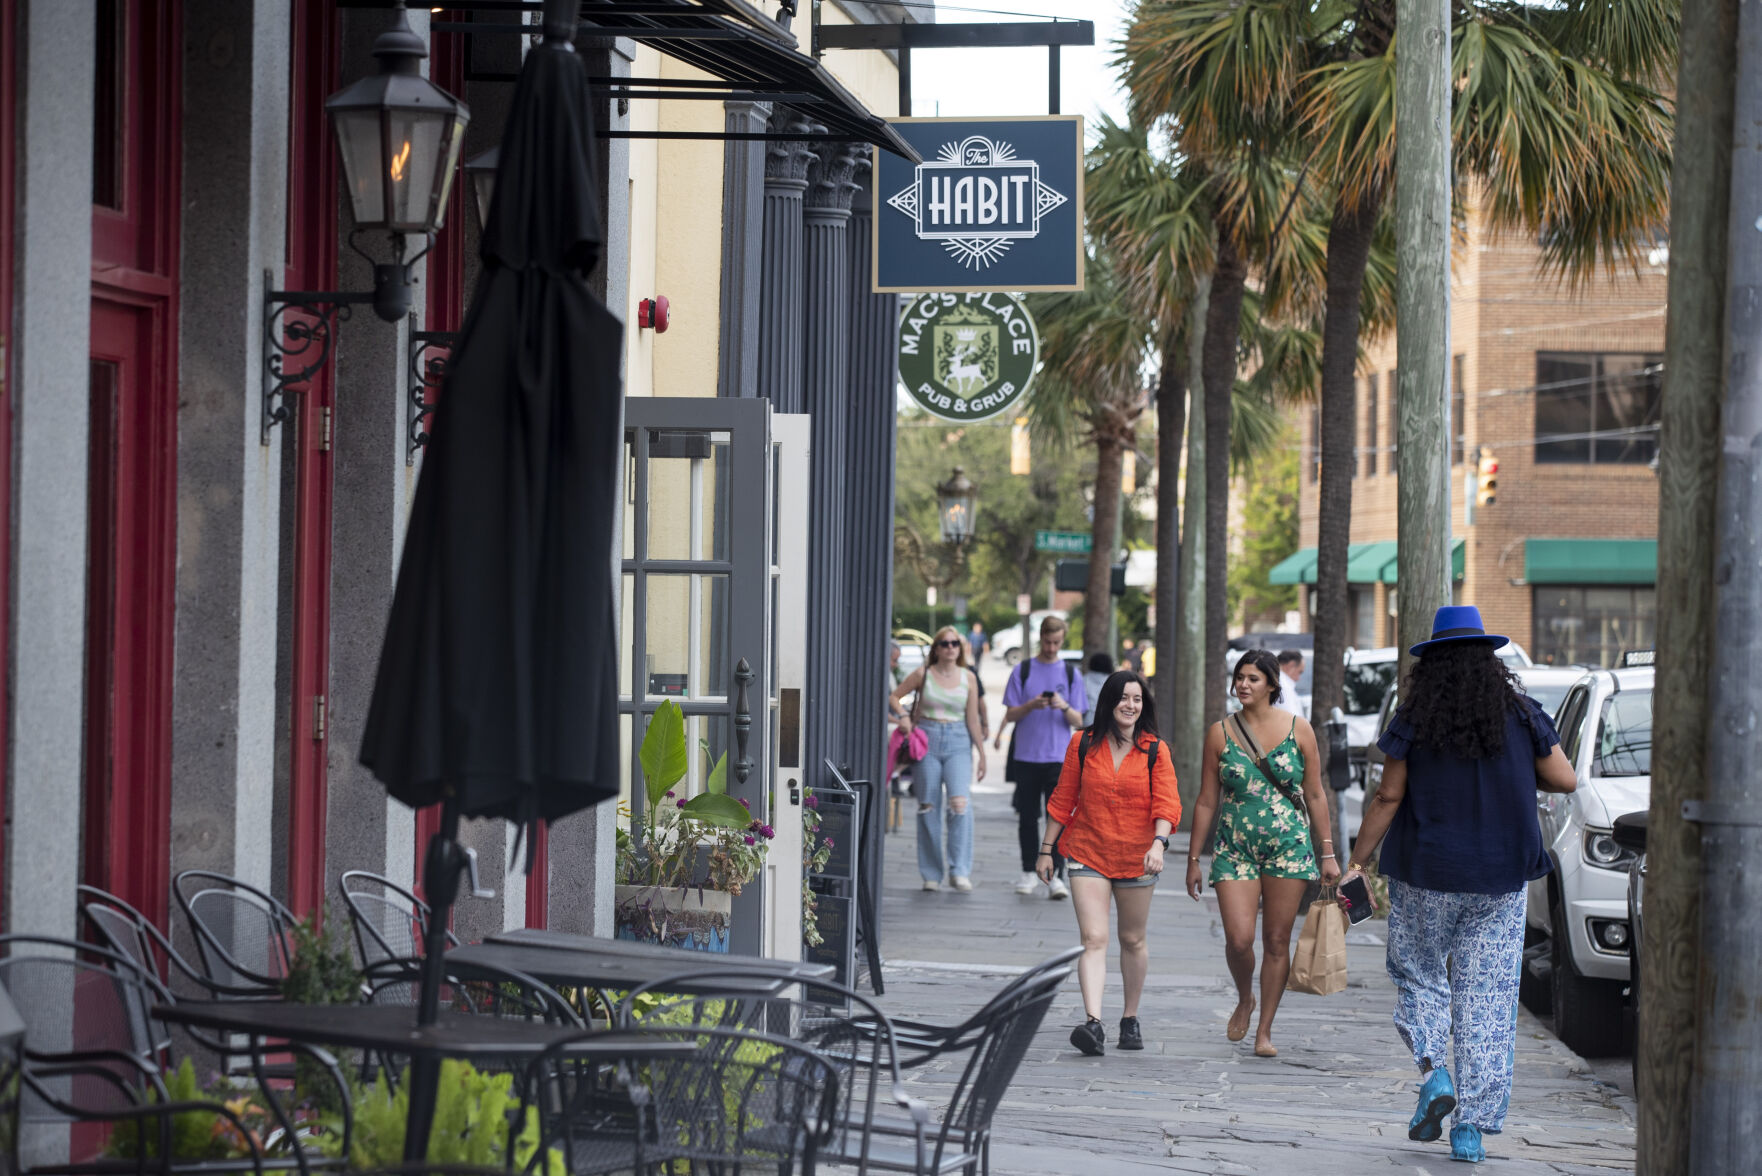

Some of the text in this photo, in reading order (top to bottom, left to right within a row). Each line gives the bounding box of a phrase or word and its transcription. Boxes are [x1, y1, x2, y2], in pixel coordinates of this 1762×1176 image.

[965, 148, 989, 165] The
[928, 175, 1030, 225] HABIT
[965, 291, 1031, 355] PLACE
[918, 381, 1015, 413] PUB & GRUB
